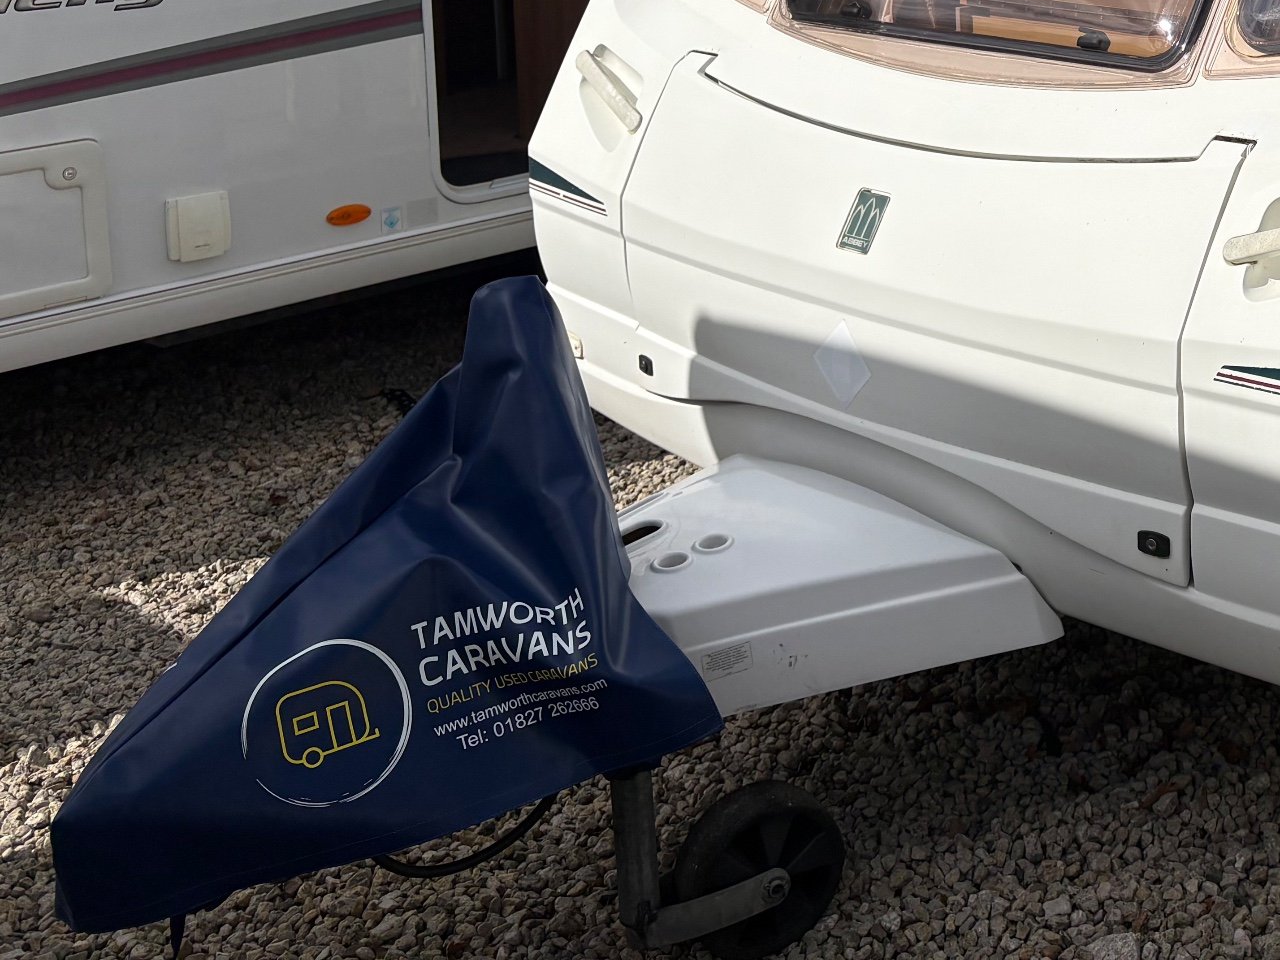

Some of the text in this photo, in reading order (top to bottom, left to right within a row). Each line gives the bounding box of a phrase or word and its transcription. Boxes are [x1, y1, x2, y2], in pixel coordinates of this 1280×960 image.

[842, 236, 869, 248] ABBEY
[411, 587, 584, 649] TAMWORTH
[419, 620, 592, 686] CARAVANS
[427, 653, 598, 713] QUALITY USED CARAVANS
[434, 678, 608, 736] www.tamworthcaravans.com
[456, 696, 600, 750] Tel: 01827 262666
